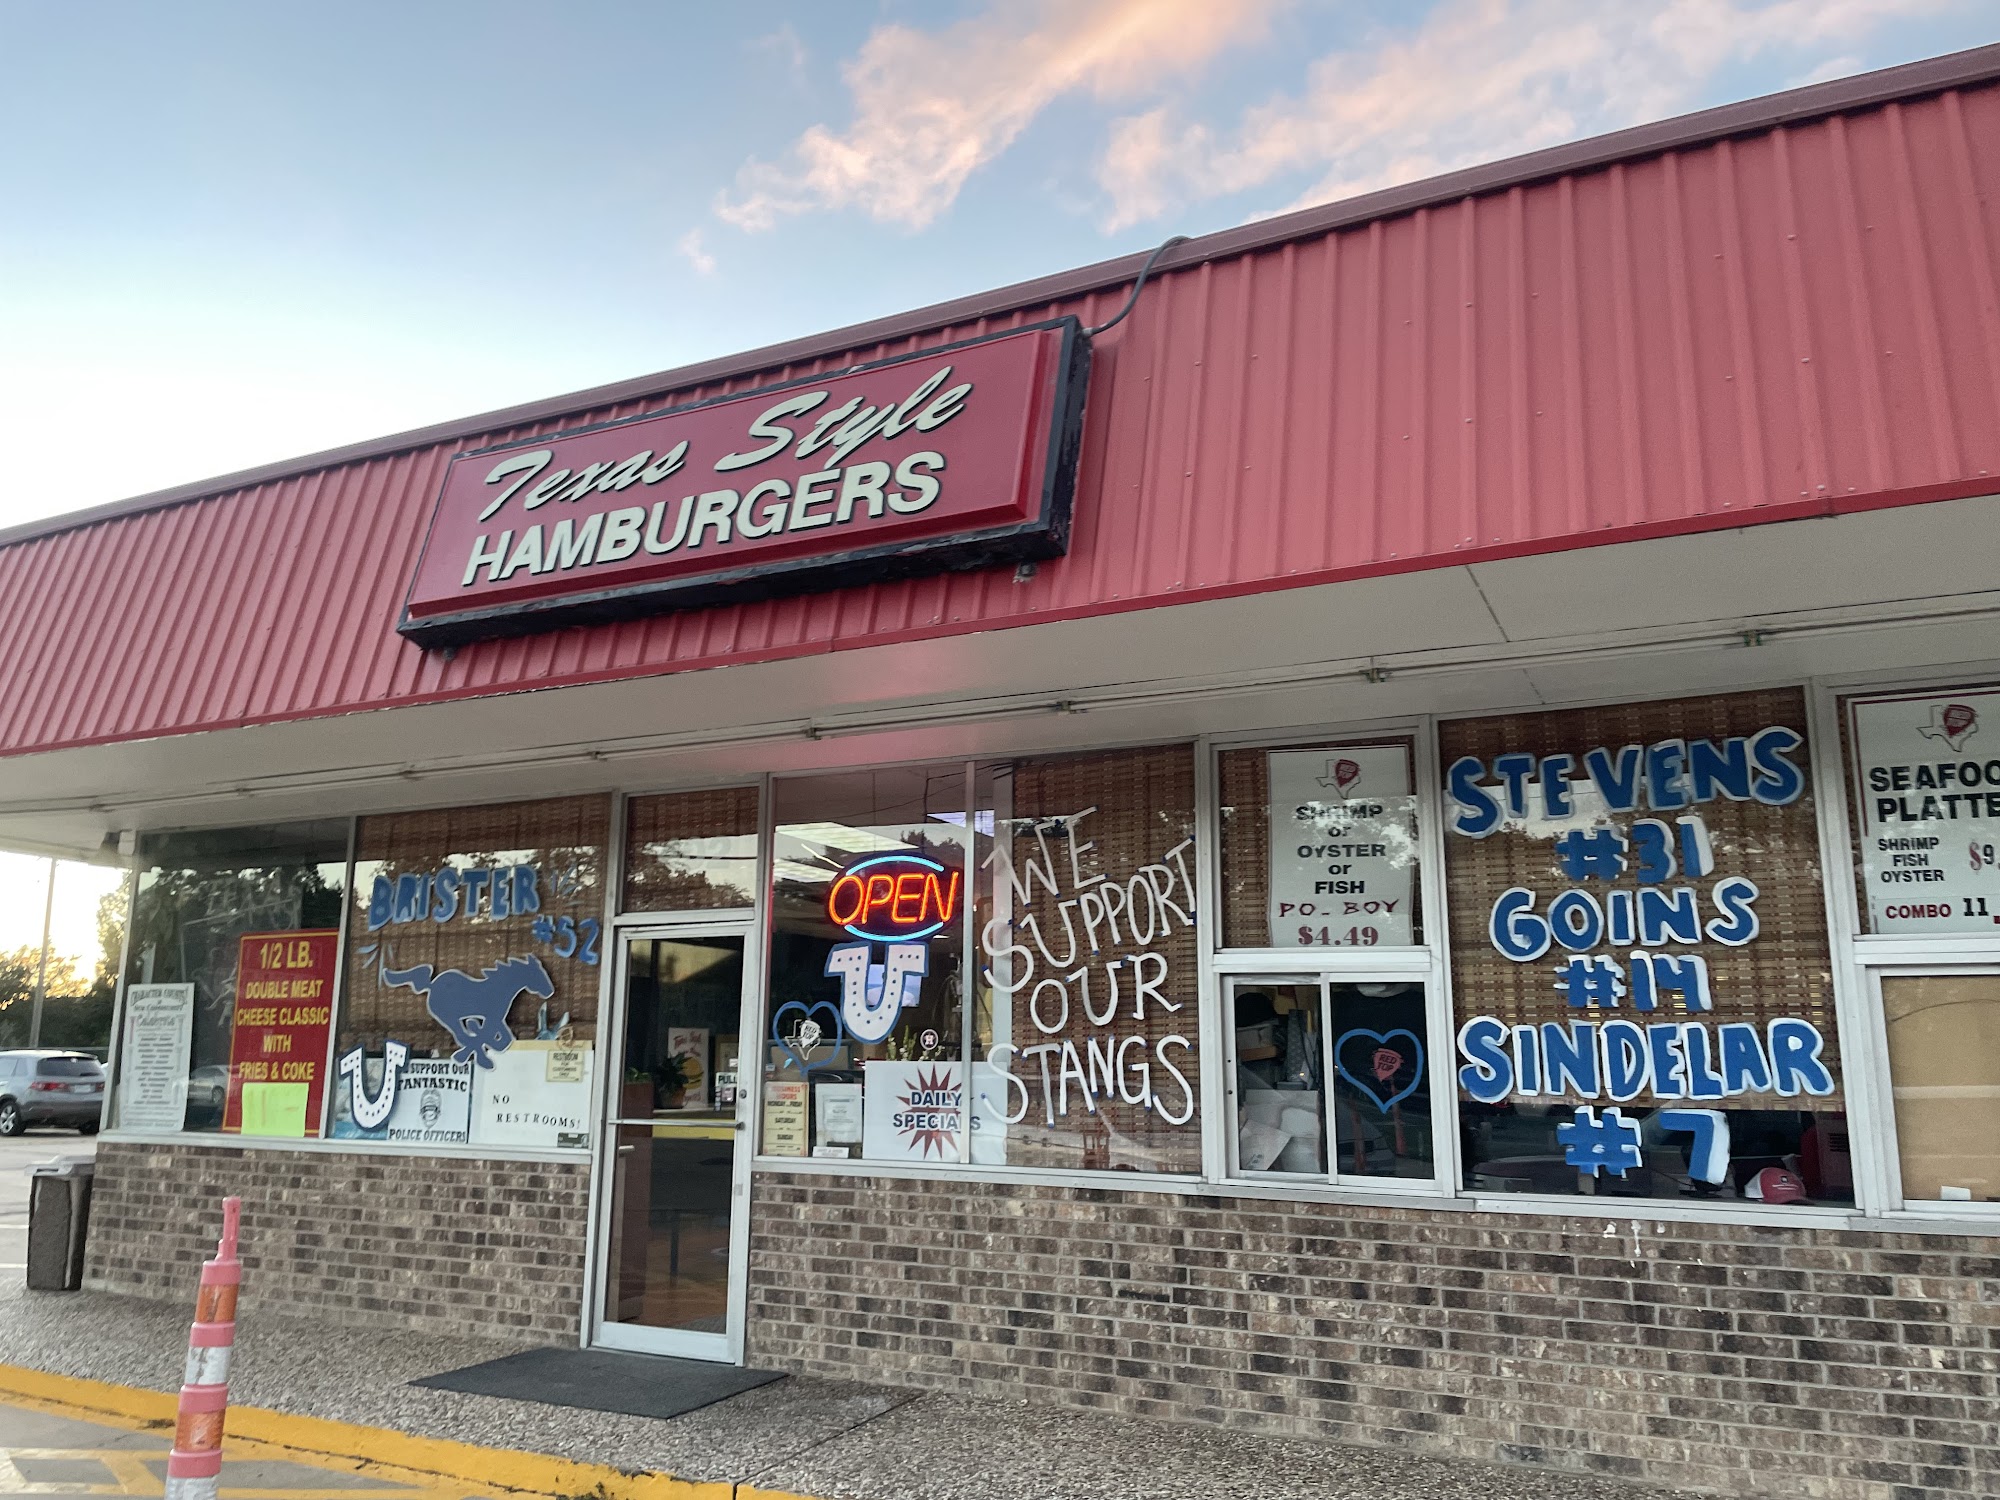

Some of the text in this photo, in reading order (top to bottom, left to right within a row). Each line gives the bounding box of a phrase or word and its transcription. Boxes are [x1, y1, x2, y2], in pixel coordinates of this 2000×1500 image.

[478, 365, 973, 522] Texas Style
[462, 451, 945, 587] HAMBURGERS
[1447, 725, 1805, 839] STEVENS
[1869, 760, 2000, 791] SEAFOO
[1877, 792, 2000, 822] PLATTE
[1297, 844, 1387, 858] OYSTER
[1555, 815, 1715, 885] #31
[1878, 837, 1940, 852] SHRIMP
[980, 806, 1108, 907] WE
[1893, 854, 1929, 867] FISH
[1328, 864, 1352, 875] or
[1881, 870, 1945, 883] OYSTER
[1315, 881, 1365, 894] FISH
[829, 871, 959, 925] OPEN
[982, 835, 1197, 993] SUPPORT
[1489, 877, 1760, 963] GOINS
[1886, 904, 1952, 919] COMBO
[530, 914, 599, 965] #52
[1298, 926, 1378, 946] $4.49
[260, 940, 314, 969] 1/2 LB.
[245, 979, 324, 999] DOUBLE MEAT
[1553, 950, 1713, 1013] #14
[1030, 953, 1184, 1033] OUR
[237, 1006, 329, 1026] CHEESE CLASSIC
[263, 1035, 291, 1052] WITH
[410, 1063, 450, 1074] SUPPORT
[452, 1063, 469, 1074] OUR
[1377, 1062, 1394, 1071] TOP
[1380, 1054, 1397, 1064] RED
[1457, 1016, 1835, 1104] SINDELAR
[238, 1061, 315, 1080] FRIES & COKE
[397, 1078, 467, 1092] FANTASTIC
[980, 1035, 1194, 1128] STANGS
[493, 1095, 510, 1105] NO
[911, 1091, 962, 1107] DAILY
[496, 1113, 581, 1129] RESTROOMS!
[893, 1113, 982, 1131] SPECIAS
[389, 1128, 467, 1142] POLICE OFFICERS
